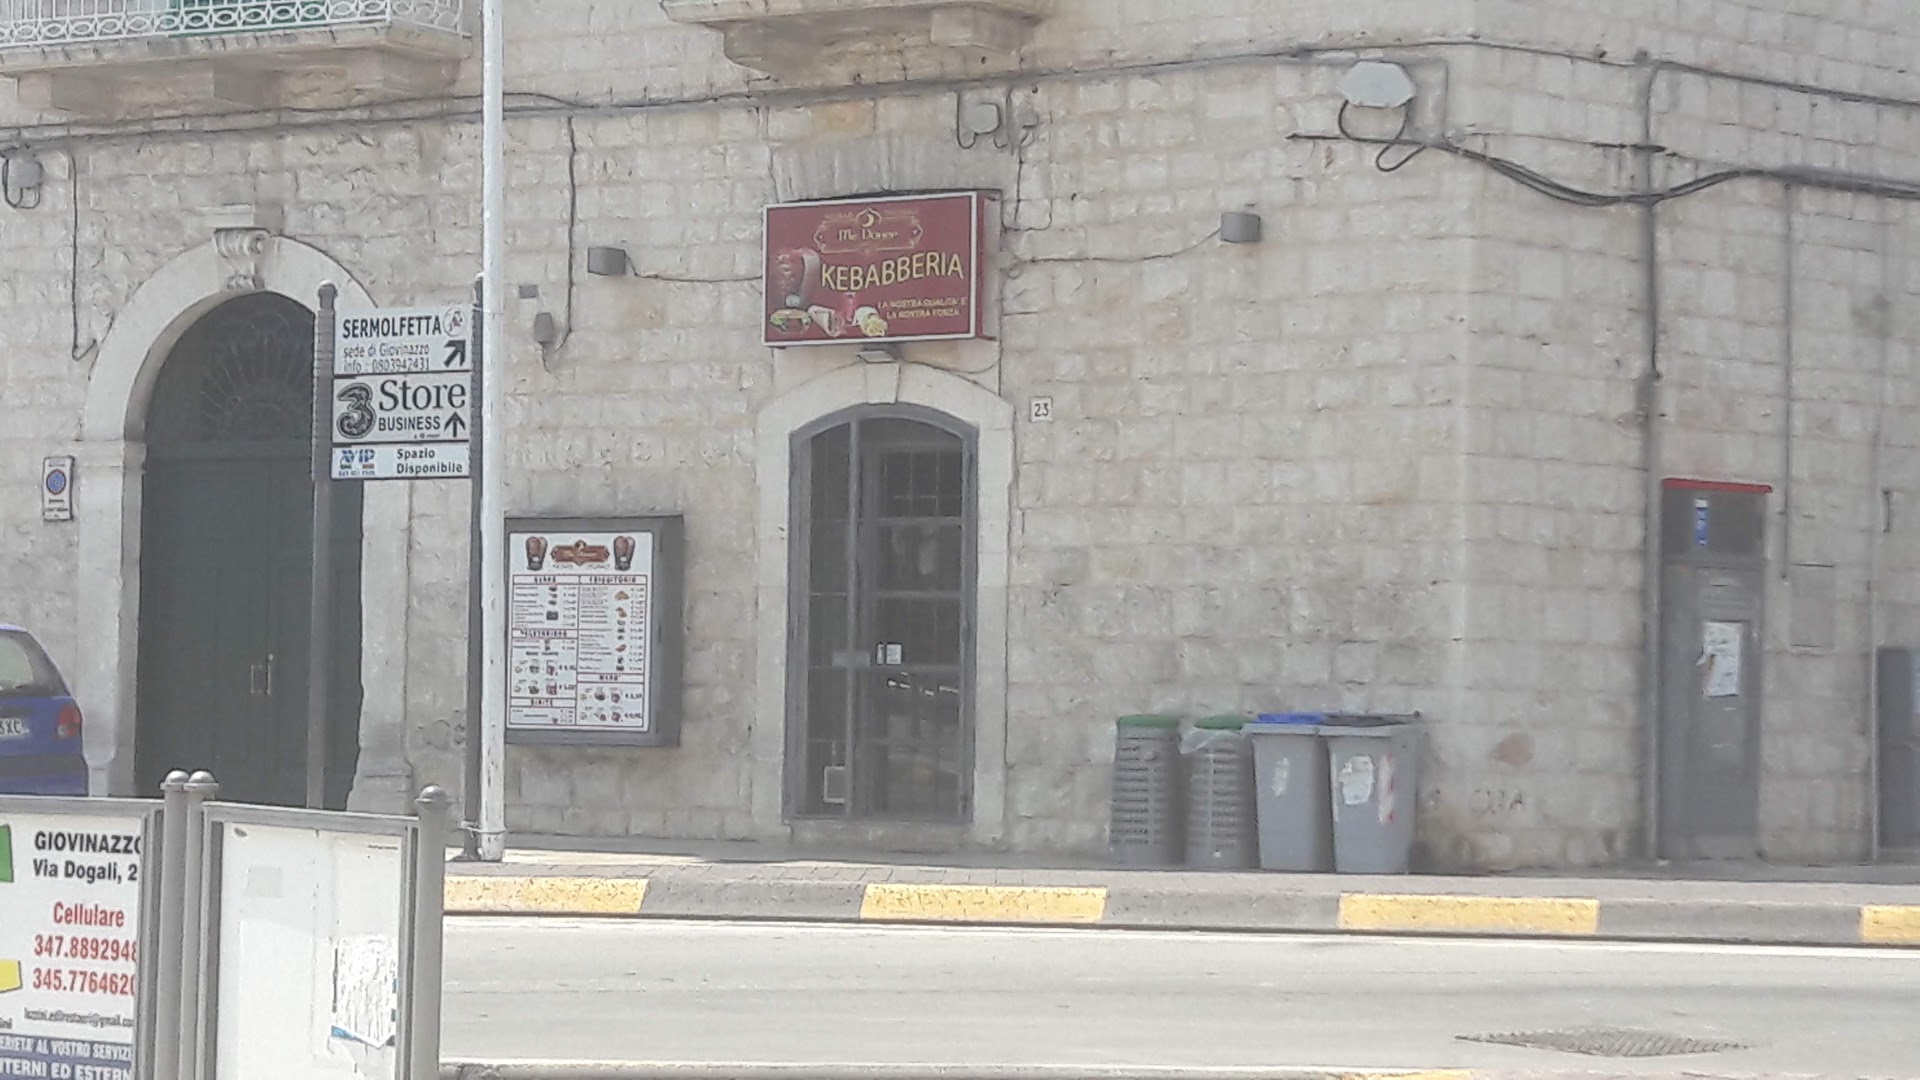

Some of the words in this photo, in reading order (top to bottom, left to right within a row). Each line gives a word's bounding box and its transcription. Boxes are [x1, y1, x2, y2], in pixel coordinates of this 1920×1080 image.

[821, 251, 964, 291] KEBABBERIA
[342, 315, 441, 339] SERMOLFETTA
[343, 344, 365, 358] sede
[367, 343, 376, 357] di
[379, 342, 429, 357] Giovinazzo
[379, 379, 467, 412] Store
[1034, 403, 1049, 417] 23
[378, 415, 441, 432] BUSINESS
[396, 447, 435, 461] Spazio
[396, 462, 463, 476] Disponibile
[33, 858, 58, 878] Via
[64, 860, 122, 884] Dogali,
[127, 863, 138, 881] 2
[53, 901, 125, 927] Cellulare
[36, 1039, 49, 1055] AL
[51, 1041, 91, 1058] VOSTRO
[51, 1062, 71, 1079] ED
